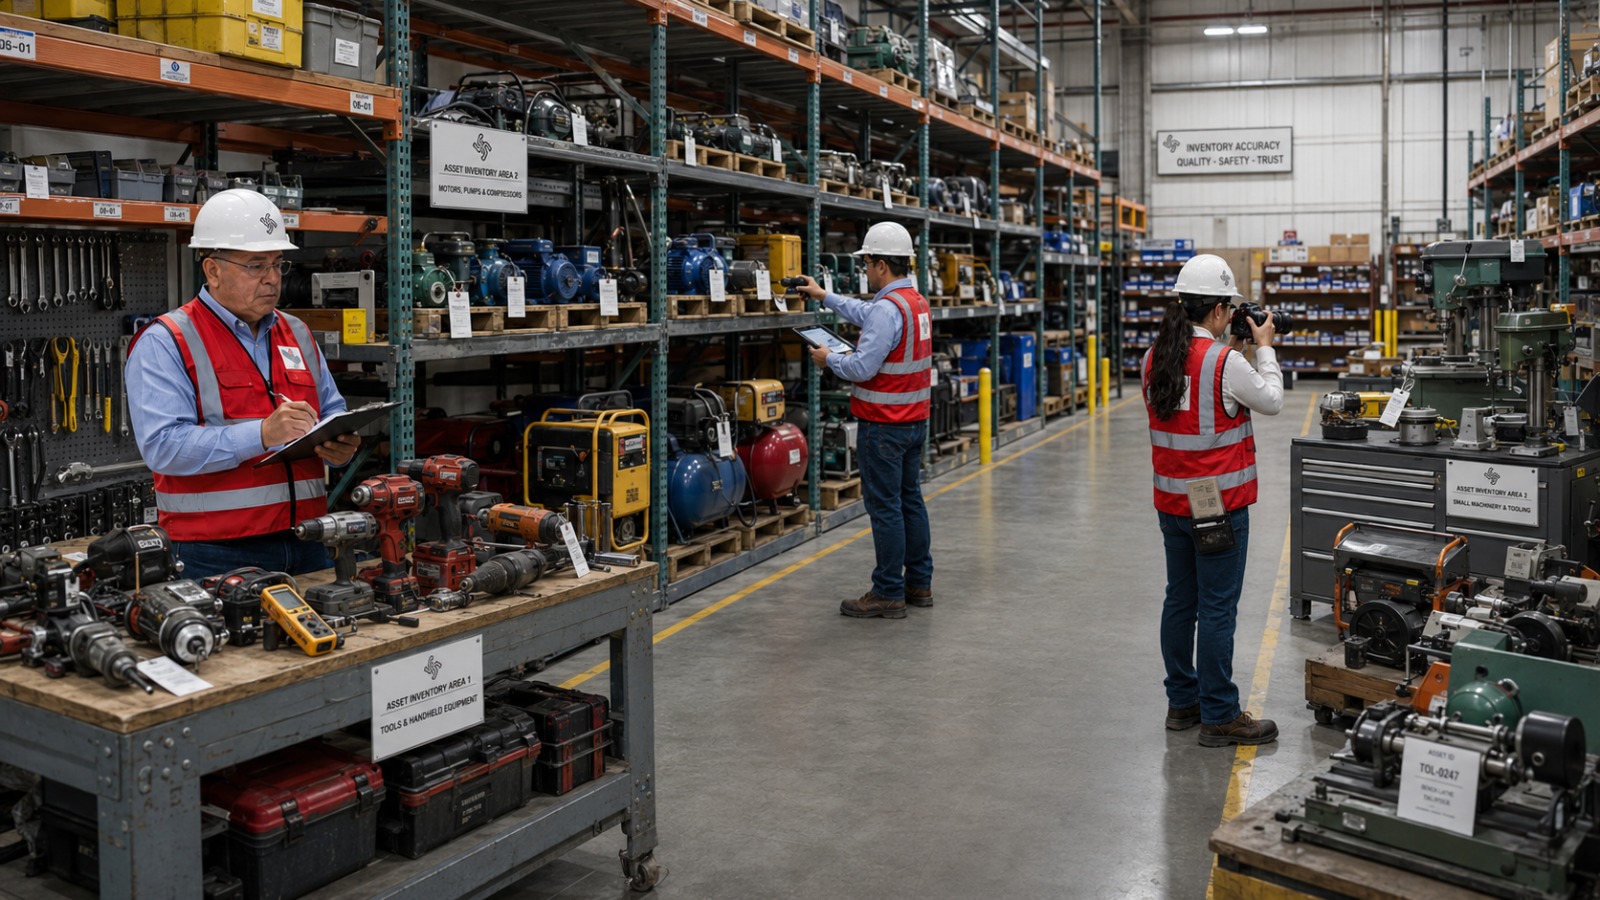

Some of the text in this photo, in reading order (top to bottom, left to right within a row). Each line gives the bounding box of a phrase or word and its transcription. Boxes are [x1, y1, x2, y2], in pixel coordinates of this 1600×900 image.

[1186, 141, 1280, 152] INVENTORY ACCURACY
[1177, 157, 1211, 167] QUALITY
[1218, 156, 1250, 166] SAFETY
[1257, 155, 1284, 164] TRUST
[443, 164, 463, 173] ASSET
[464, 166, 497, 177] INVENTORY
[498, 170, 513, 179] AREA
[438, 184, 462, 194] MOTORS,
[463, 187, 481, 195] PUMPS
[1456, 485, 1474, 493] ASSET
[1475, 487, 1506, 496] INVENTORY
[1507, 490, 1523, 498] AREA
[1471, 501, 1502, 510] MACHINERY
[1508, 505, 1531, 513] TOOLING
[386, 675, 471, 711] ASSET INVENTORY AREA 1
[380, 694, 478, 734] TOOLS & HANDHELD EQUIPMENT
[1419, 763, 1459, 780] TOL-0247
